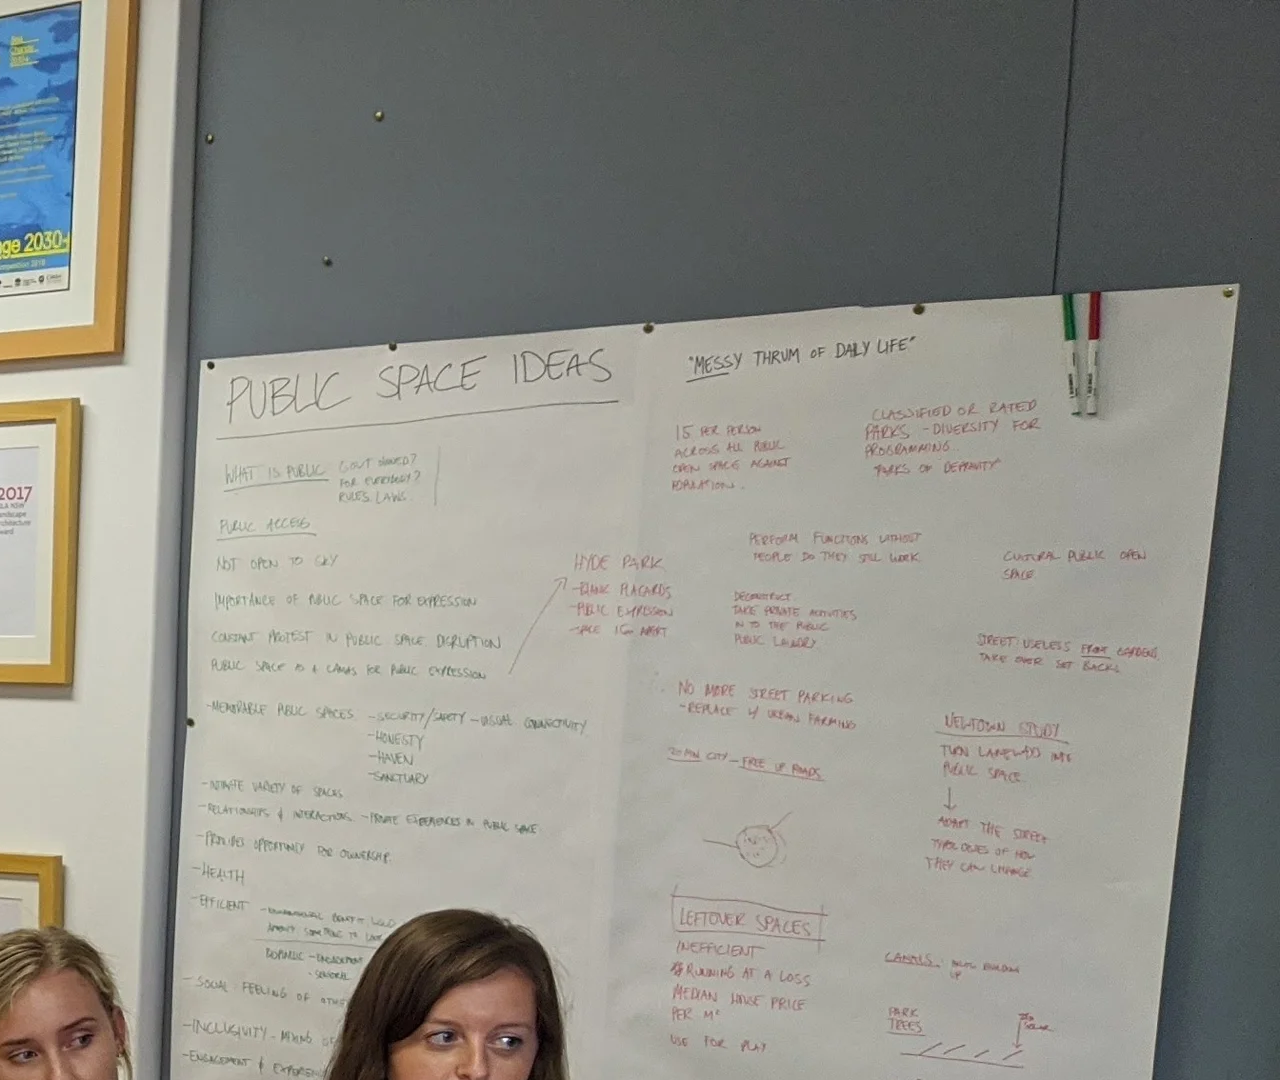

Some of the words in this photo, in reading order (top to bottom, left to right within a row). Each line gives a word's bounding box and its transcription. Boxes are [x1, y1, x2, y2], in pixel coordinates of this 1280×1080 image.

[754, 348, 800, 367] THRUM
[810, 349, 825, 360] OF
[836, 341, 871, 360] DAILY
[877, 336, 916, 355] LIFE"
[226, 372, 351, 424] PUBLIC
[377, 356, 487, 400] SPACE
[513, 349, 612, 384] IDEAS
[872, 405, 952, 422] CLASSIFIED
[957, 403, 978, 416] OR
[990, 399, 1037, 414] RATED
[676, 425, 694, 441] 15
[700, 425, 720, 436] PER
[726, 425, 762, 436] PERSON
[865, 423, 910, 441] PARKS
[1012, 418, 1041, 432] FOR
[675, 444, 720, 458] ACROSS
[727, 442, 743, 452] ALL
[865, 440, 950, 458] PROGRAMMING
[709, 459, 740, 471] SPACE
[225, 464, 264, 484] WHAT
[269, 466, 282, 479] IS
[266, 517, 310, 532] ACCESS
[749, 532, 799, 546] PERFORM
[813, 531, 869, 546] FUNCTIONS
[879, 532, 922, 545] WITHOUT
[216, 557, 240, 571] NOT
[251, 557, 279, 570] OPEN
[574, 553, 610, 571] HYDE
[622, 554, 664, 571] PARK
[753, 552, 792, 563] PEOPLE
[801, 552, 815, 562] DO
[822, 551, 847, 562] THEY
[858, 552, 881, 564] STILL
[890, 552, 921, 563] WORK
[1003, 550, 1060, 562] CULTURAL
[1068, 550, 1105, 562] PUBLIC
[1120, 549, 1147, 560] OPEN
[1003, 568, 1035, 580] SPACE
[620, 582, 672, 600] PLACARDS
[215, 592, 276, 611] IMPORTANCE
[350, 592, 383, 606] SPACE
[392, 593, 412, 606] FOR
[417, 594, 477, 608] EXPRESSION
[764, 605, 800, 617] PRIVATE
[211, 630, 258, 644] CONSTANT
[268, 630, 314, 644] PROTEST
[346, 632, 382, 648] PUBLIC
[436, 634, 502, 649] DISRUPTION
[1023, 638, 1072, 653] USELESS
[428, 665, 487, 681] EXPRESSION
[678, 679, 694, 695] NO
[704, 682, 737, 697] MORE
[749, 687, 790, 700] STREET
[797, 689, 853, 705] PARKING
[316, 705, 354, 719] SPACES
[768, 707, 800, 723] URBAN
[808, 713, 856, 730] FARMING
[945, 712, 1006, 733] NEWTOWN
[1019, 721, 1059, 739] STUDY
[940, 744, 969, 758] TURN
[706, 752, 728, 761] CITY
[743, 756, 765, 769] FREE
[943, 761, 978, 778] PUBLIC
[988, 766, 1021, 781] SPACE
[938, 815, 969, 829] ADAPT
[980, 821, 1003, 838] THE
[925, 856, 954, 871] THEY
[680, 906, 745, 927] LEFTOVER
[756, 914, 811, 937] SPACES
[676, 940, 766, 959] INEFFICIENT
[742, 967, 757, 980] AT
[764, 970, 772, 981] A
[780, 970, 811, 987] LOSS
[197, 977, 228, 993] SOCIAL
[242, 981, 288, 999] FEELING
[672, 983, 718, 1003] MEDIAN
[771, 997, 808, 1011] PRICE
[672, 1006, 693, 1021] PER
[888, 1007, 919, 1018] PARK
[888, 1018, 923, 1033] TREES
[670, 1034, 689, 1047] USE
[704, 1035, 727, 1049] FOR
